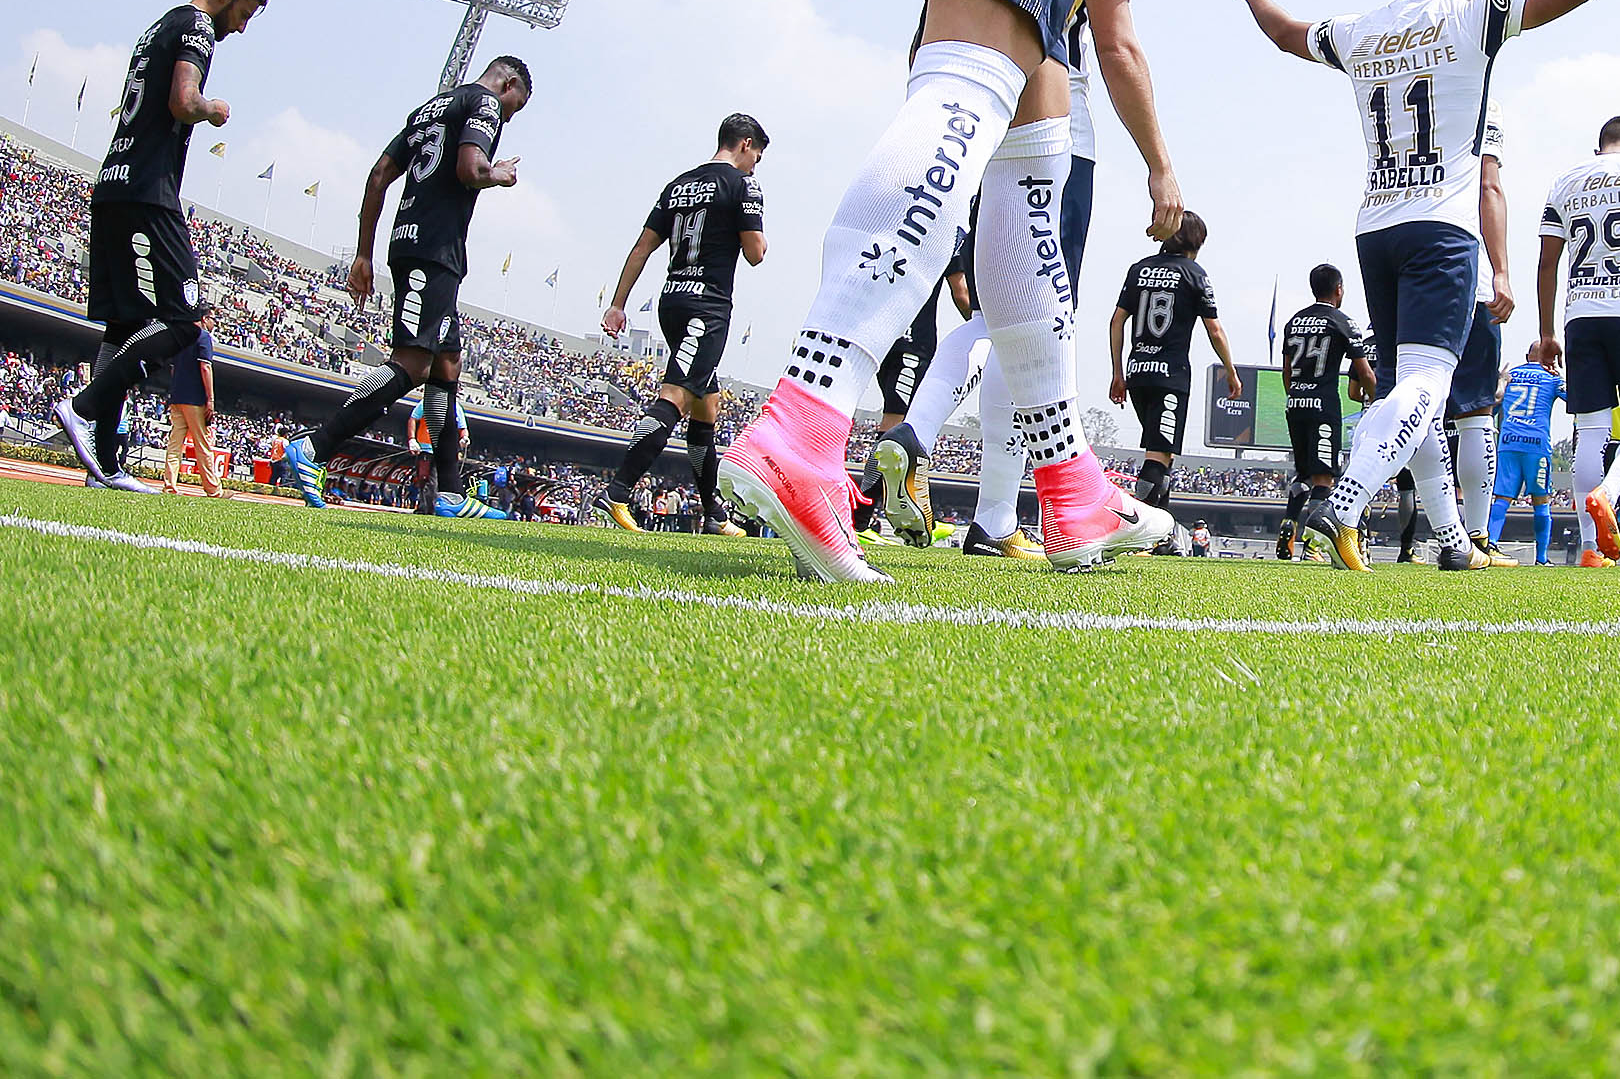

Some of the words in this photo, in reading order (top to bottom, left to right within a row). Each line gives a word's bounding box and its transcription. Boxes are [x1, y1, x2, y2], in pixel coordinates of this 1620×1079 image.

[1374, 18, 1446, 55] telcel
[1354, 45, 1457, 78] HERBALIFE
[1368, 74, 1442, 170] 11
[897, 103, 980, 245] interjet
[1370, 165, 1445, 191] RABELLO
[671, 181, 717, 197] Office
[670, 208, 707, 263] 14
[1018, 175, 1073, 303] interjet
[1139, 267, 1181, 280] Office
[663, 281, 706, 298] orona
[1135, 289, 1175, 338] 18
[1292, 317, 1327, 327] Office
[1290, 326, 1326, 335] DEPOT
[1127, 358, 1170, 378] Corona
[1287, 335, 1331, 378] 24
[1217, 397, 1251, 409] Corona
[1287, 397, 1323, 411] orona
[1508, 386, 1539, 416] 21
[1502, 433, 1541, 444] Corona
[762, 455, 798, 500] MERCURIAL
